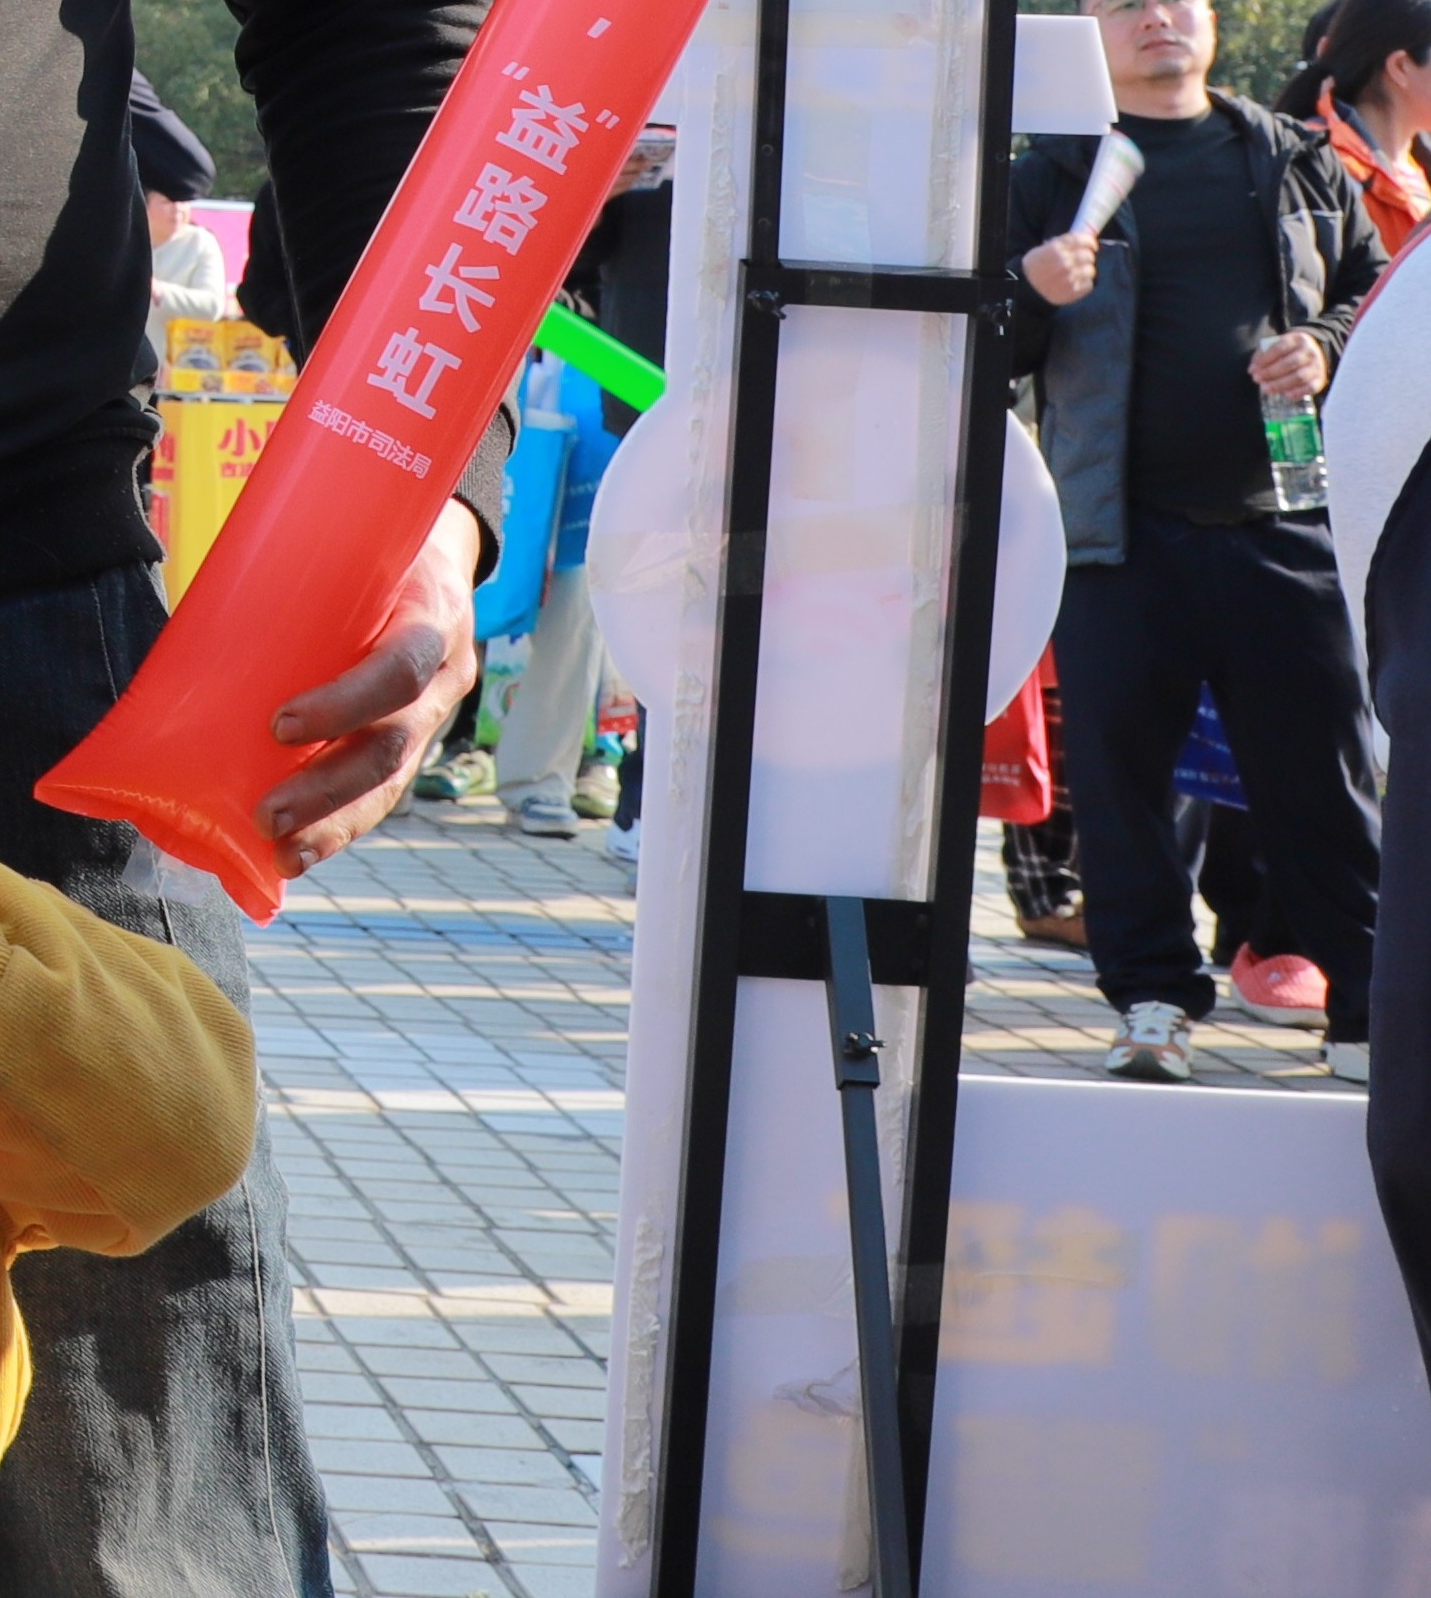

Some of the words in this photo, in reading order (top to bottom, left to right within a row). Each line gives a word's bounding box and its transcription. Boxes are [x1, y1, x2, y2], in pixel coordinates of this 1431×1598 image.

[307, 399, 434, 481] 益阳市司法局
